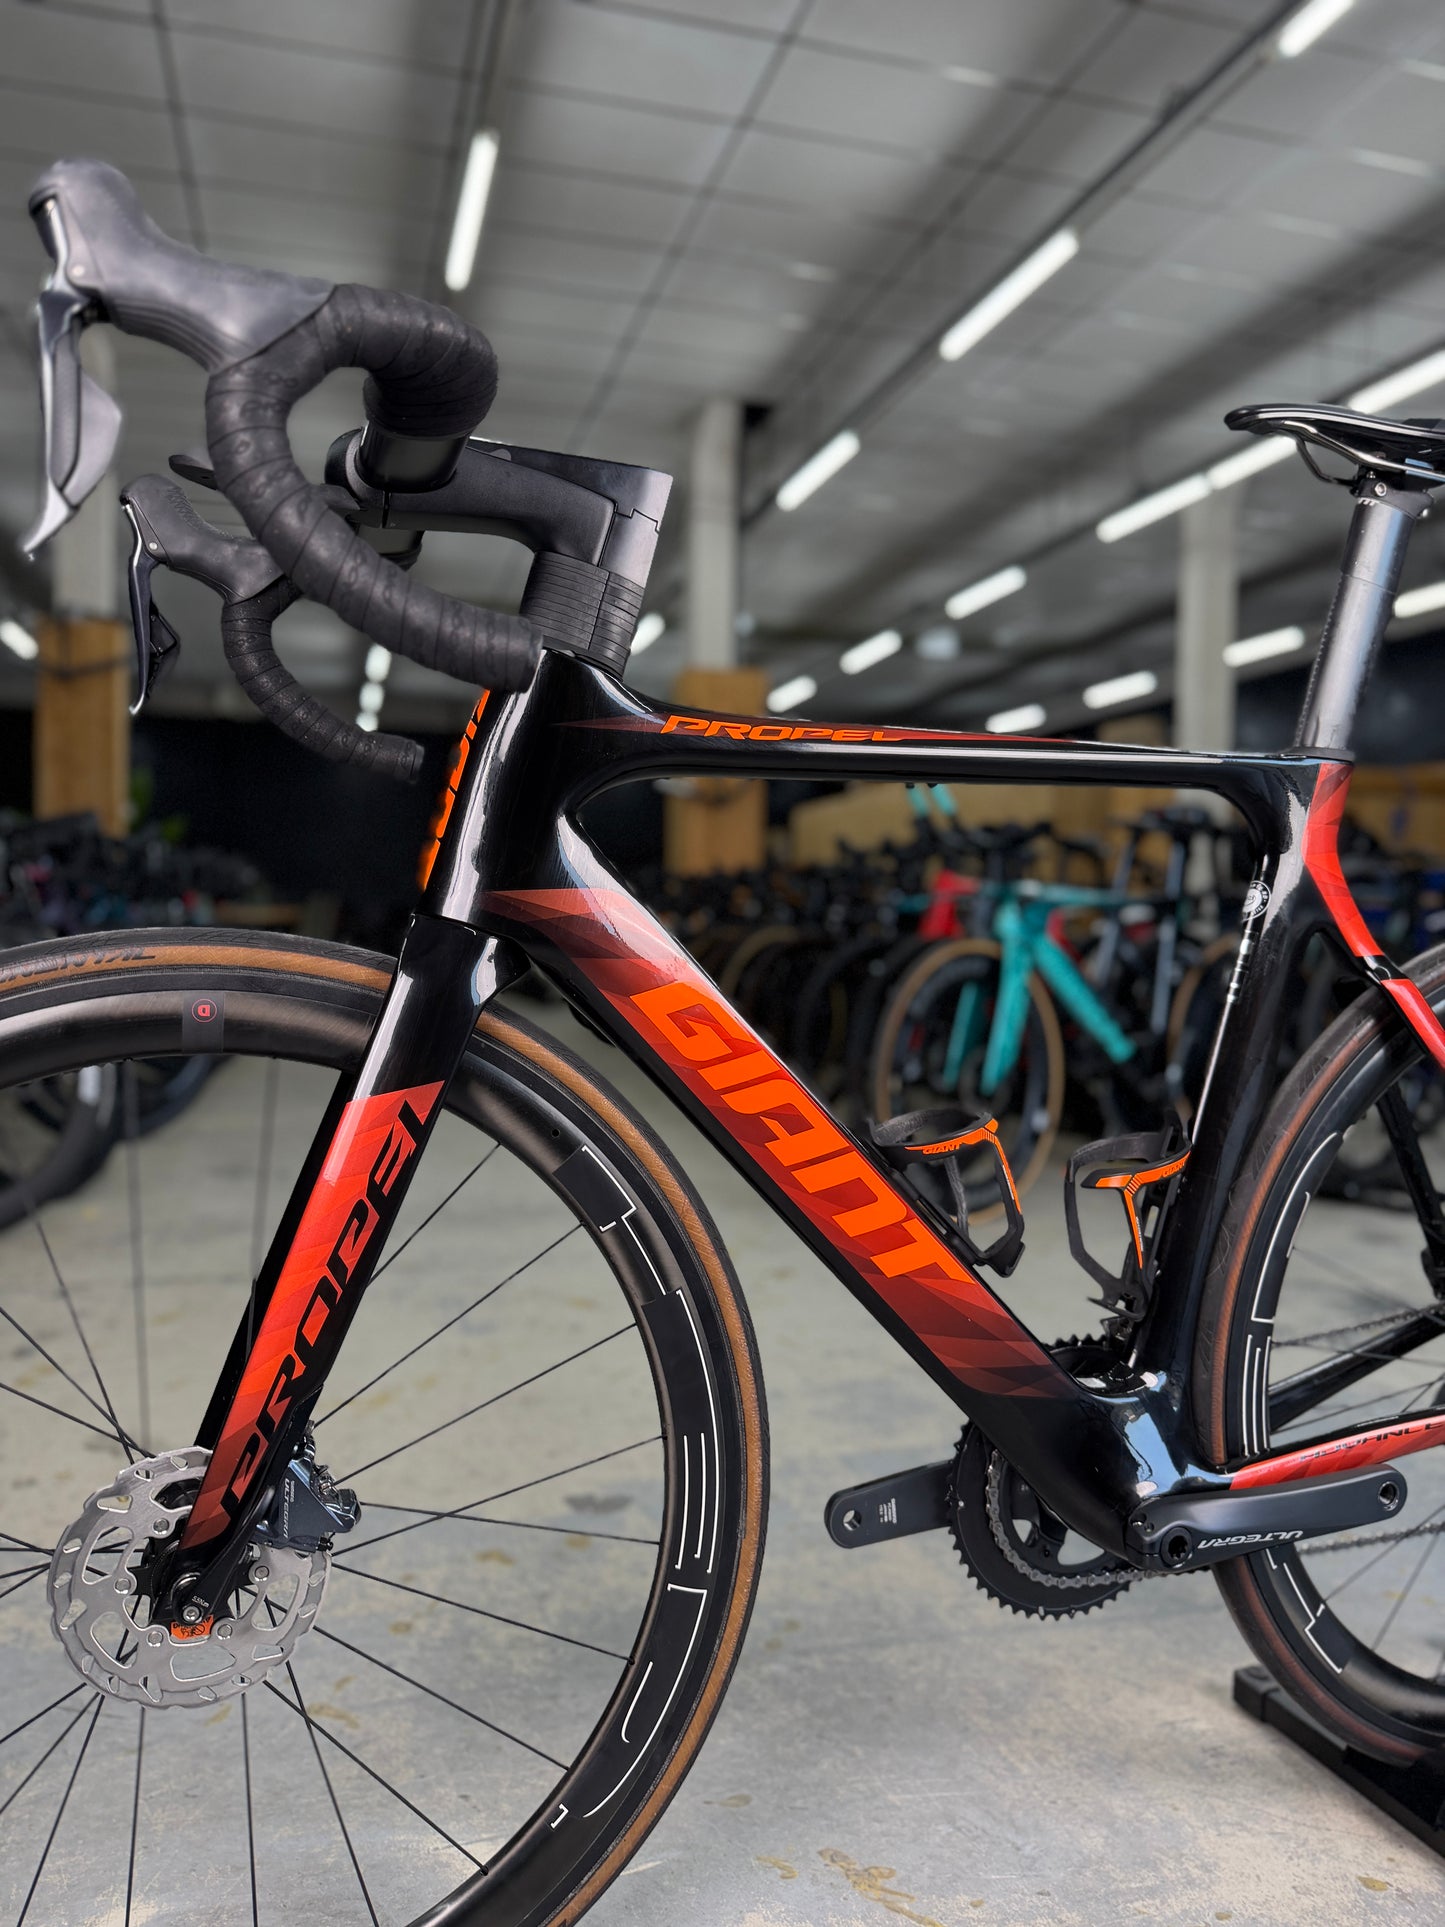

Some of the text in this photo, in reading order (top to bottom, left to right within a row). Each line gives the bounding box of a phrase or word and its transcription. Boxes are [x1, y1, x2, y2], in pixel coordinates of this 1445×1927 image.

[660, 714, 906, 742] PROPEL
[630, 980, 976, 1284] GIANT
[922, 1144, 962, 1155] GIANT
[219, 1099, 428, 1521] PROPEL
[1197, 1530, 1303, 1549] ULTEGRA
